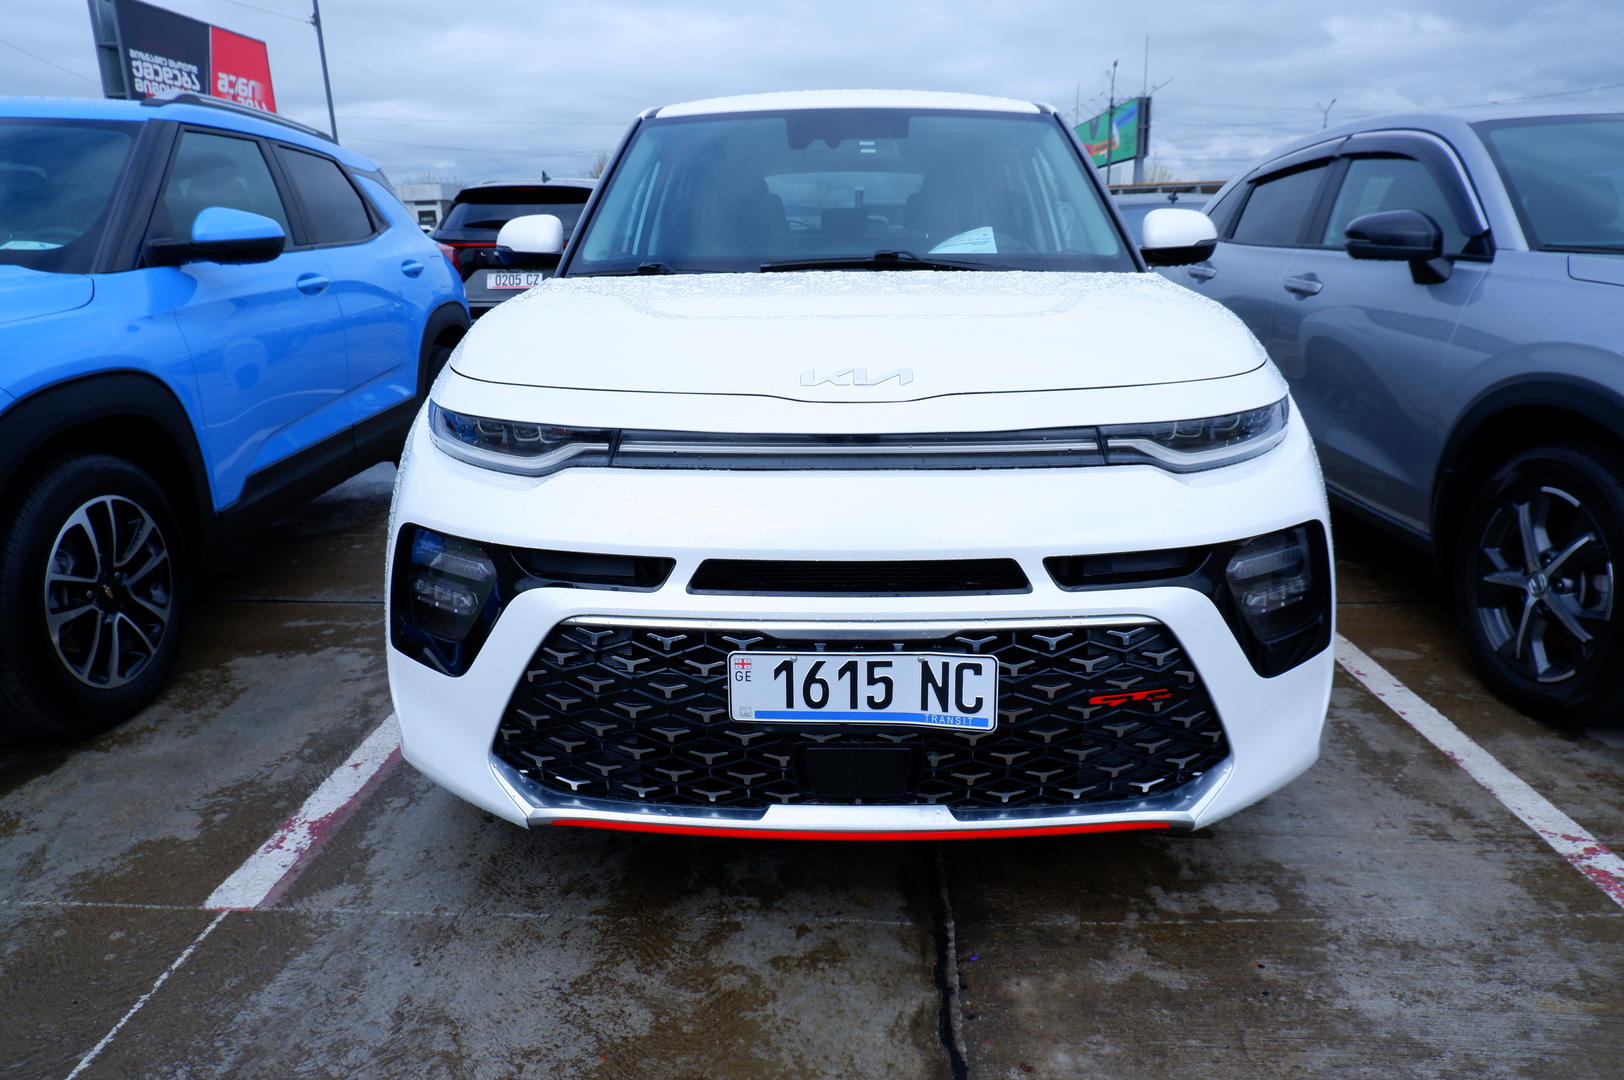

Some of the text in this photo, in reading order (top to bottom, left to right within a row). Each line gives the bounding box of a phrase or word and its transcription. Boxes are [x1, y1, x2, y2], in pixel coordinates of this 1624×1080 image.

[495, 273, 540, 286] 0205 CZ
[735, 670, 752, 682] GE
[773, 660, 984, 715] 1615 NC
[923, 714, 974, 727] TRANSIT
